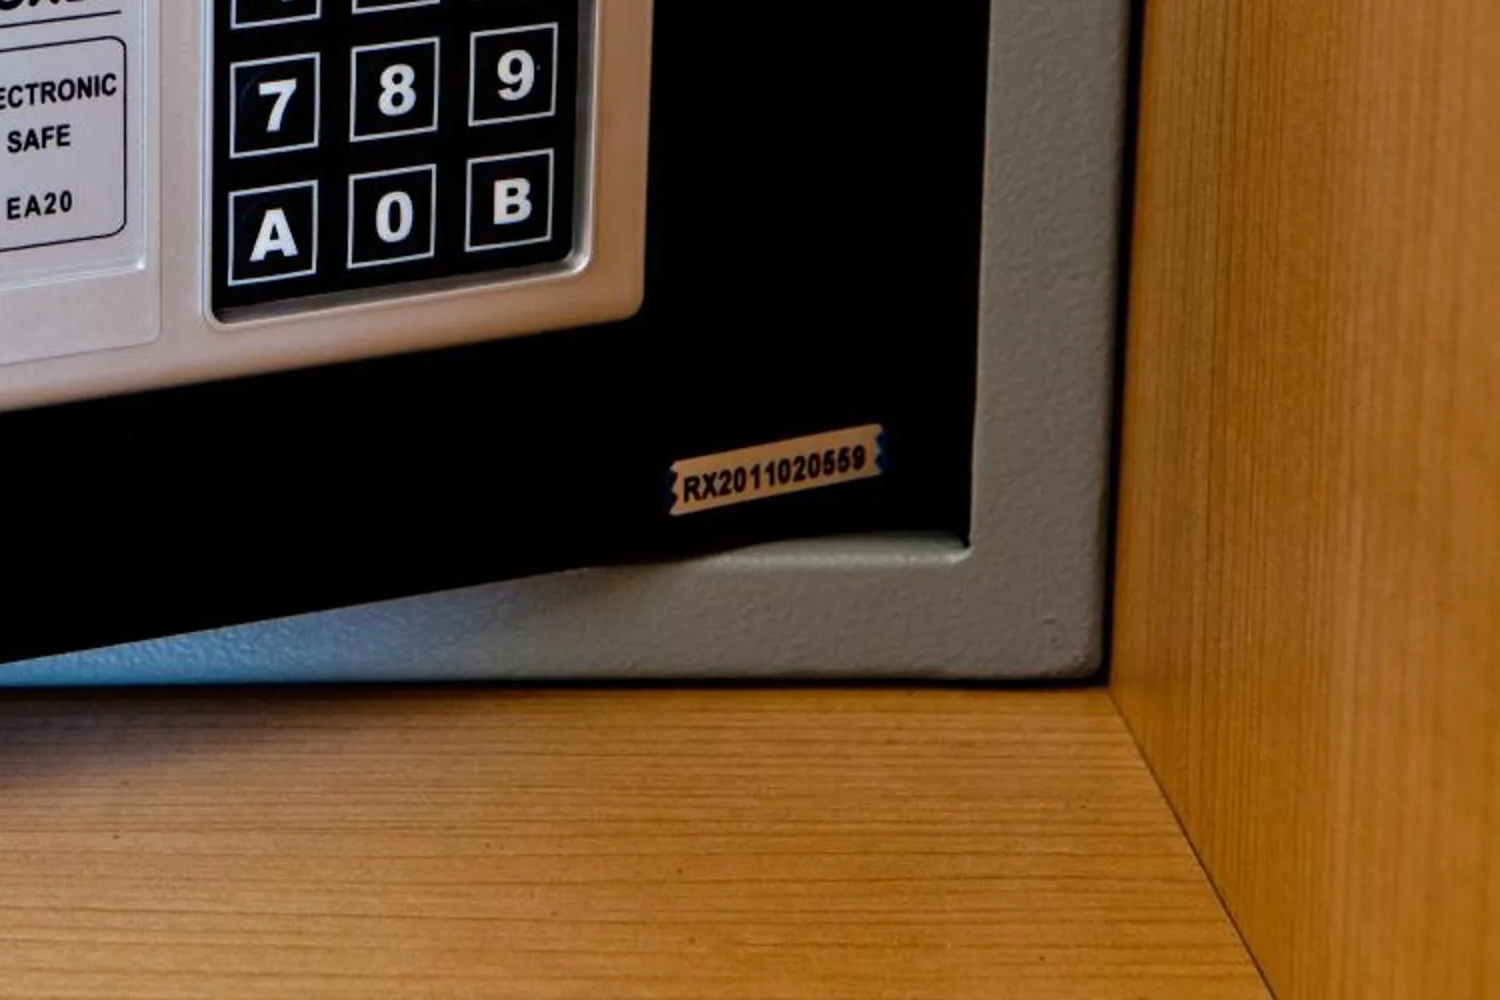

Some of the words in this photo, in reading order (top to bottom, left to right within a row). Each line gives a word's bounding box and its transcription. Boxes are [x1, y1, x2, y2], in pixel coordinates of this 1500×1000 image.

[378, 64, 416, 116] 8
[497, 49, 535, 101] 9
[258, 78, 297, 132] 7
[6, 123, 72, 154] SAFE
[6, 189, 74, 221] EA20
[375, 191, 413, 243] 0
[492, 177, 533, 225] B
[249, 208, 299, 262] A
